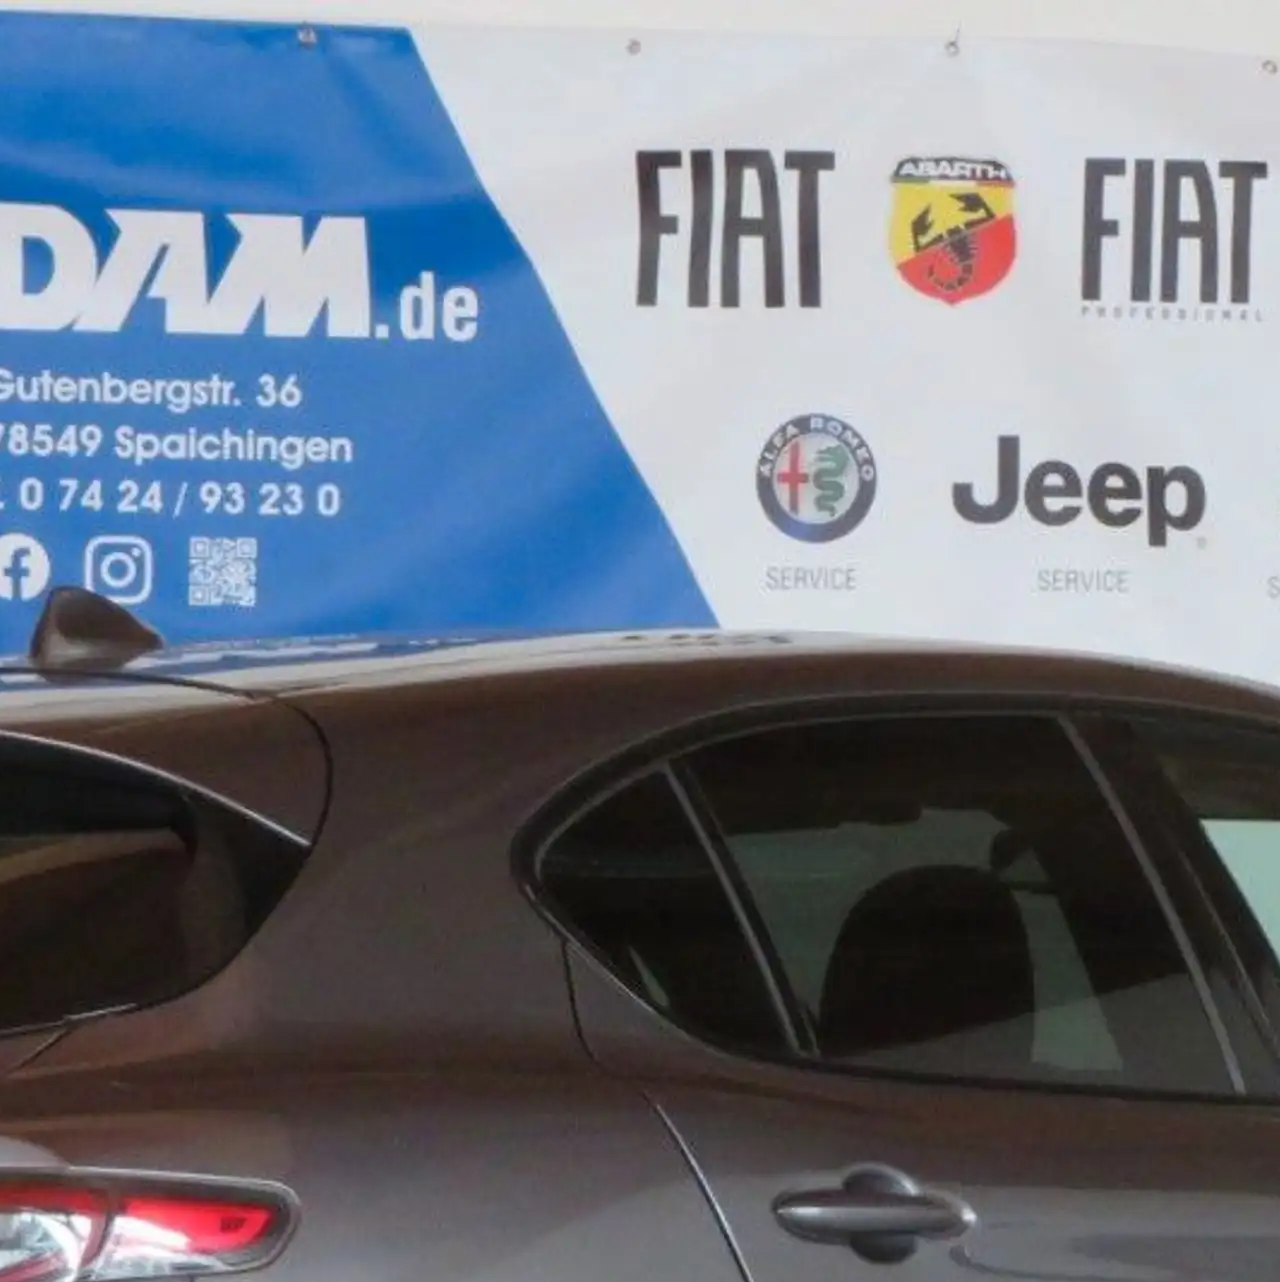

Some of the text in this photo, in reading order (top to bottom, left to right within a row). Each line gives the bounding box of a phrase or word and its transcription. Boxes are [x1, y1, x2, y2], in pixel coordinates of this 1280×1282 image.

[898, 160, 1008, 180] ABARTH
[636, 149, 835, 307] FIAT
[1082, 158, 1268, 303] FIAT
[256, 374, 302, 408] 36
[114, 425, 353, 470] Spaichingen
[809, 415, 874, 482] ROMEO
[20, 477, 44, 511] 0
[58, 479, 103, 512] 74
[117, 480, 163, 513] 24
[172, 482, 189, 519] /
[199, 481, 246, 515] 93
[258, 483, 305, 516] 23
[317, 483, 341, 517] 0
[952, 434, 1206, 548] Jeep
[765, 566, 857, 591] SERVICE
[1037, 568, 1129, 594] SERVICE
